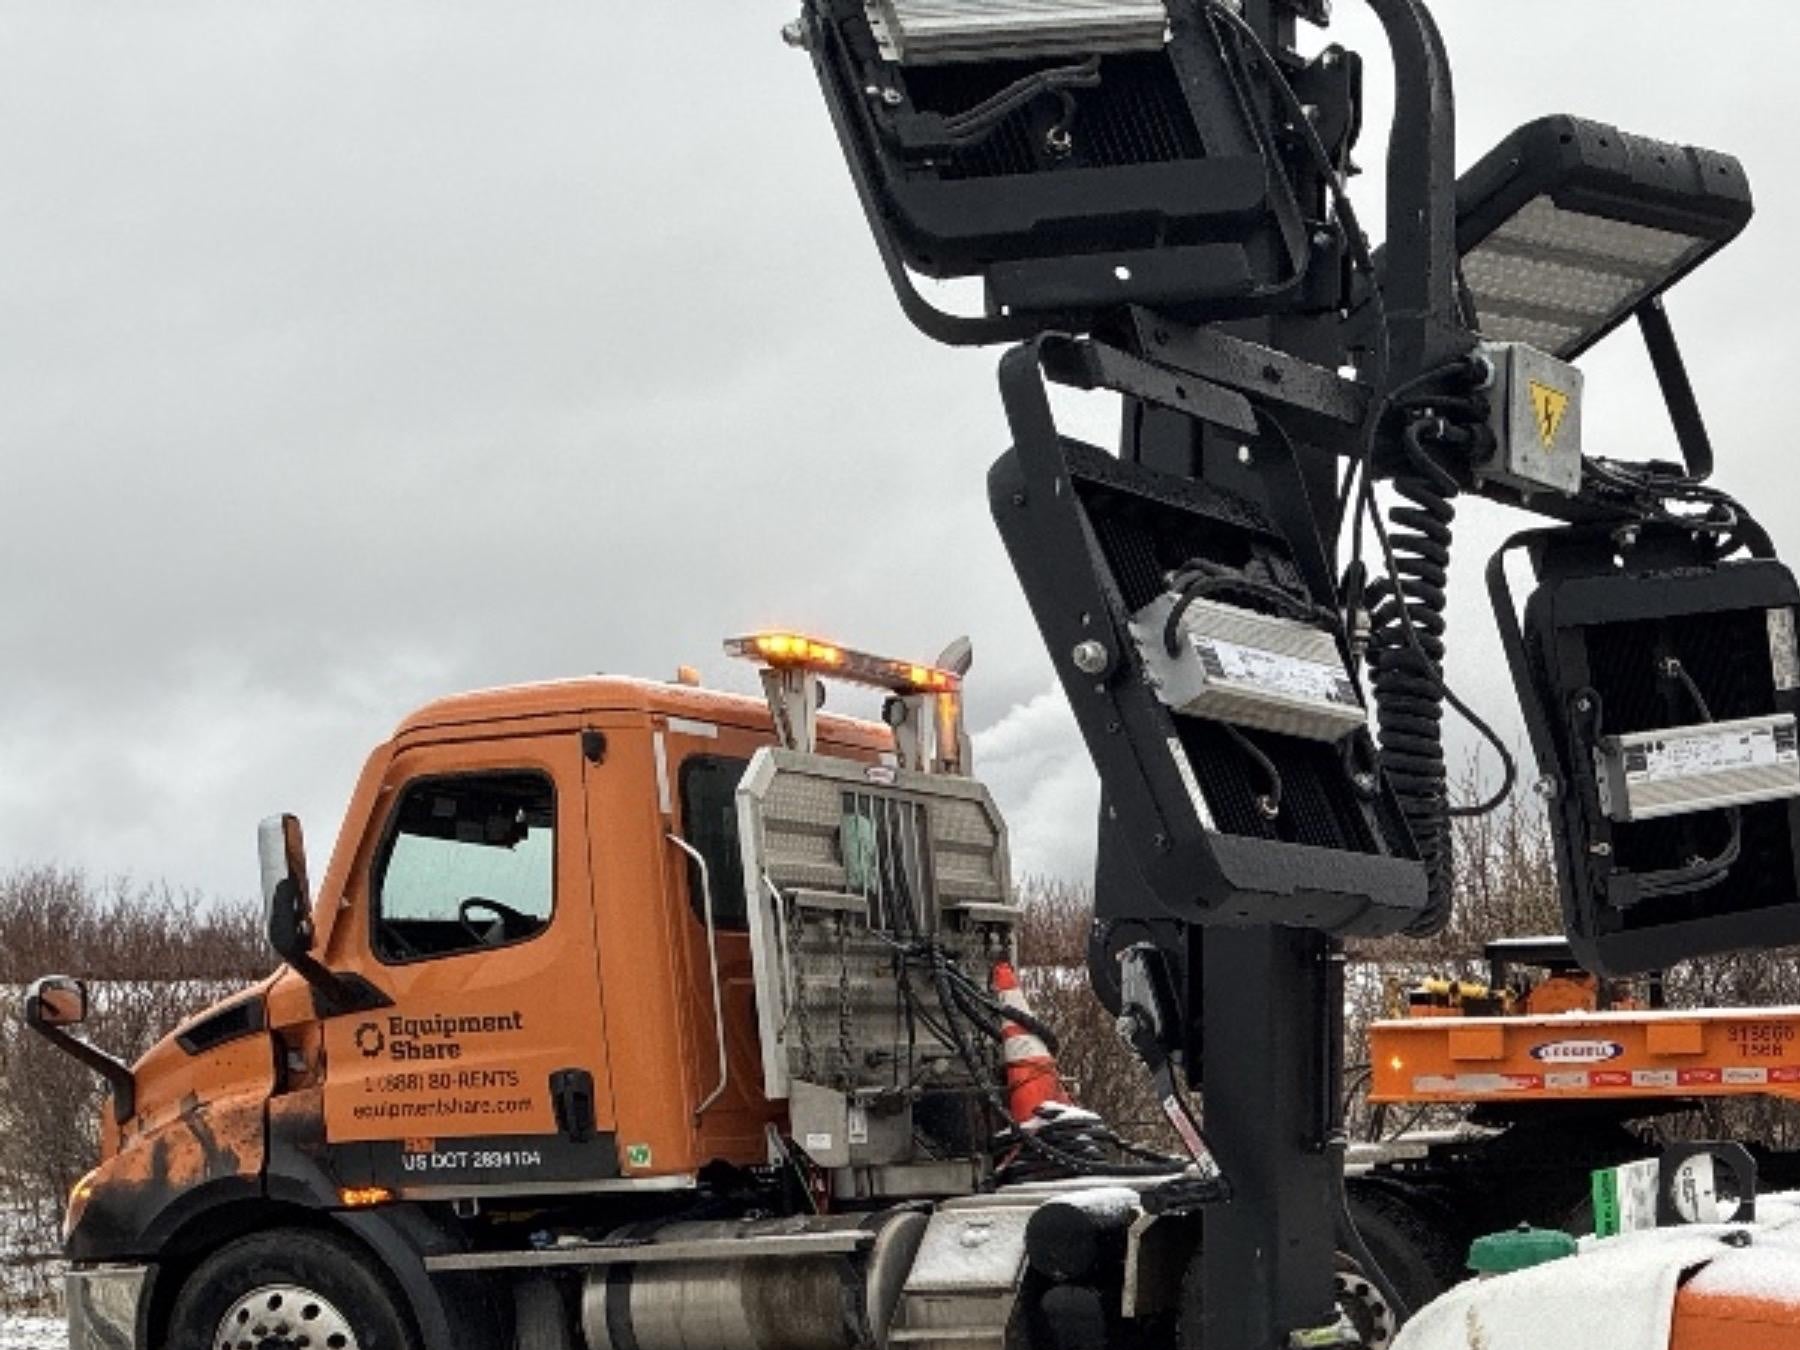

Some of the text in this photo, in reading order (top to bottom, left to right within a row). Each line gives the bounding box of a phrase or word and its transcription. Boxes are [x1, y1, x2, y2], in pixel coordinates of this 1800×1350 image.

[387, 1011, 524, 1039] Equipment
[389, 1040, 462, 1061] Share
[428, 1069, 520, 1089] 80-RENTS
[353, 1097, 533, 1121] equipmentshare.com
[402, 1153, 427, 1171] US
[431, 1151, 468, 1169] DOT
